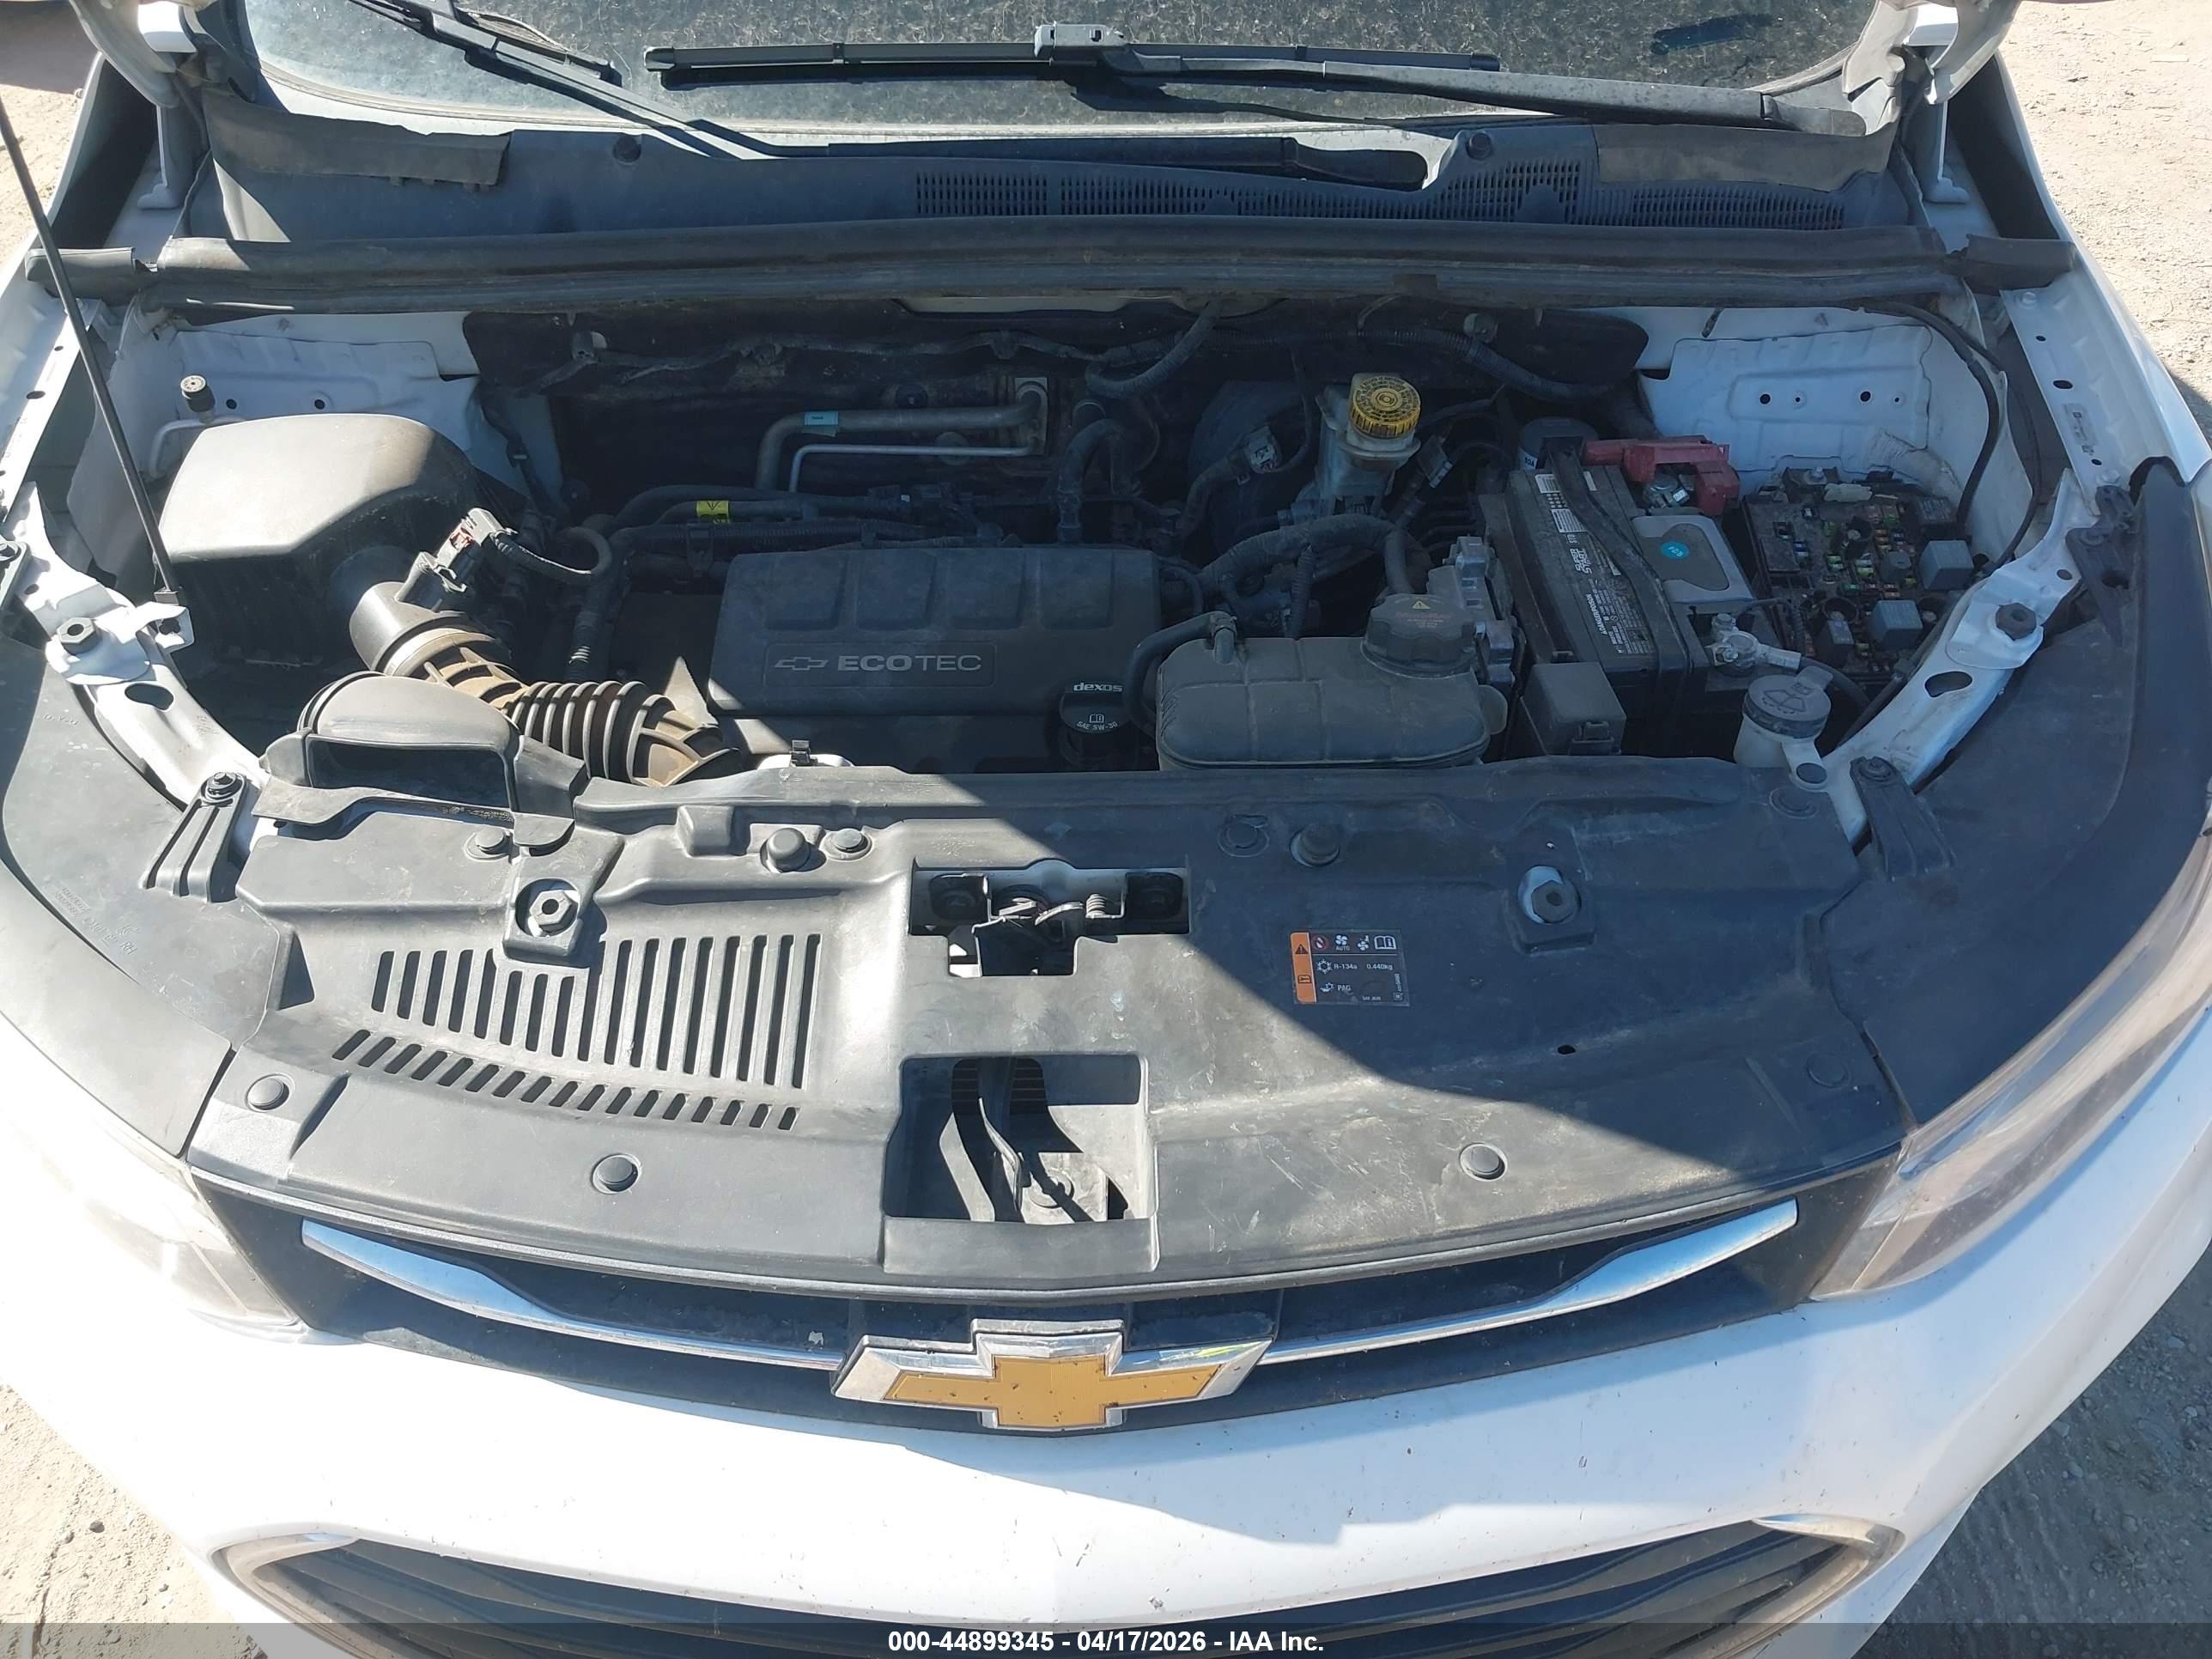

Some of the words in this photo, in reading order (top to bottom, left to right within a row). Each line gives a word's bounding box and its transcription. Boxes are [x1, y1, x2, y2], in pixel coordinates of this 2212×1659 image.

[1566, 533, 1578, 544] STD
[1570, 548, 1583, 570] SUPER
[1577, 548, 1593, 574] START
[838, 655, 981, 672] ECOTEC
[1073, 682, 1123, 692] dexos
[1076, 721, 1091, 730] SAE
[1092, 721, 1118, 731] 5W-30
[1366, 963, 1393, 971] 0.440kg
[1337, 983, 1352, 992] PAG
